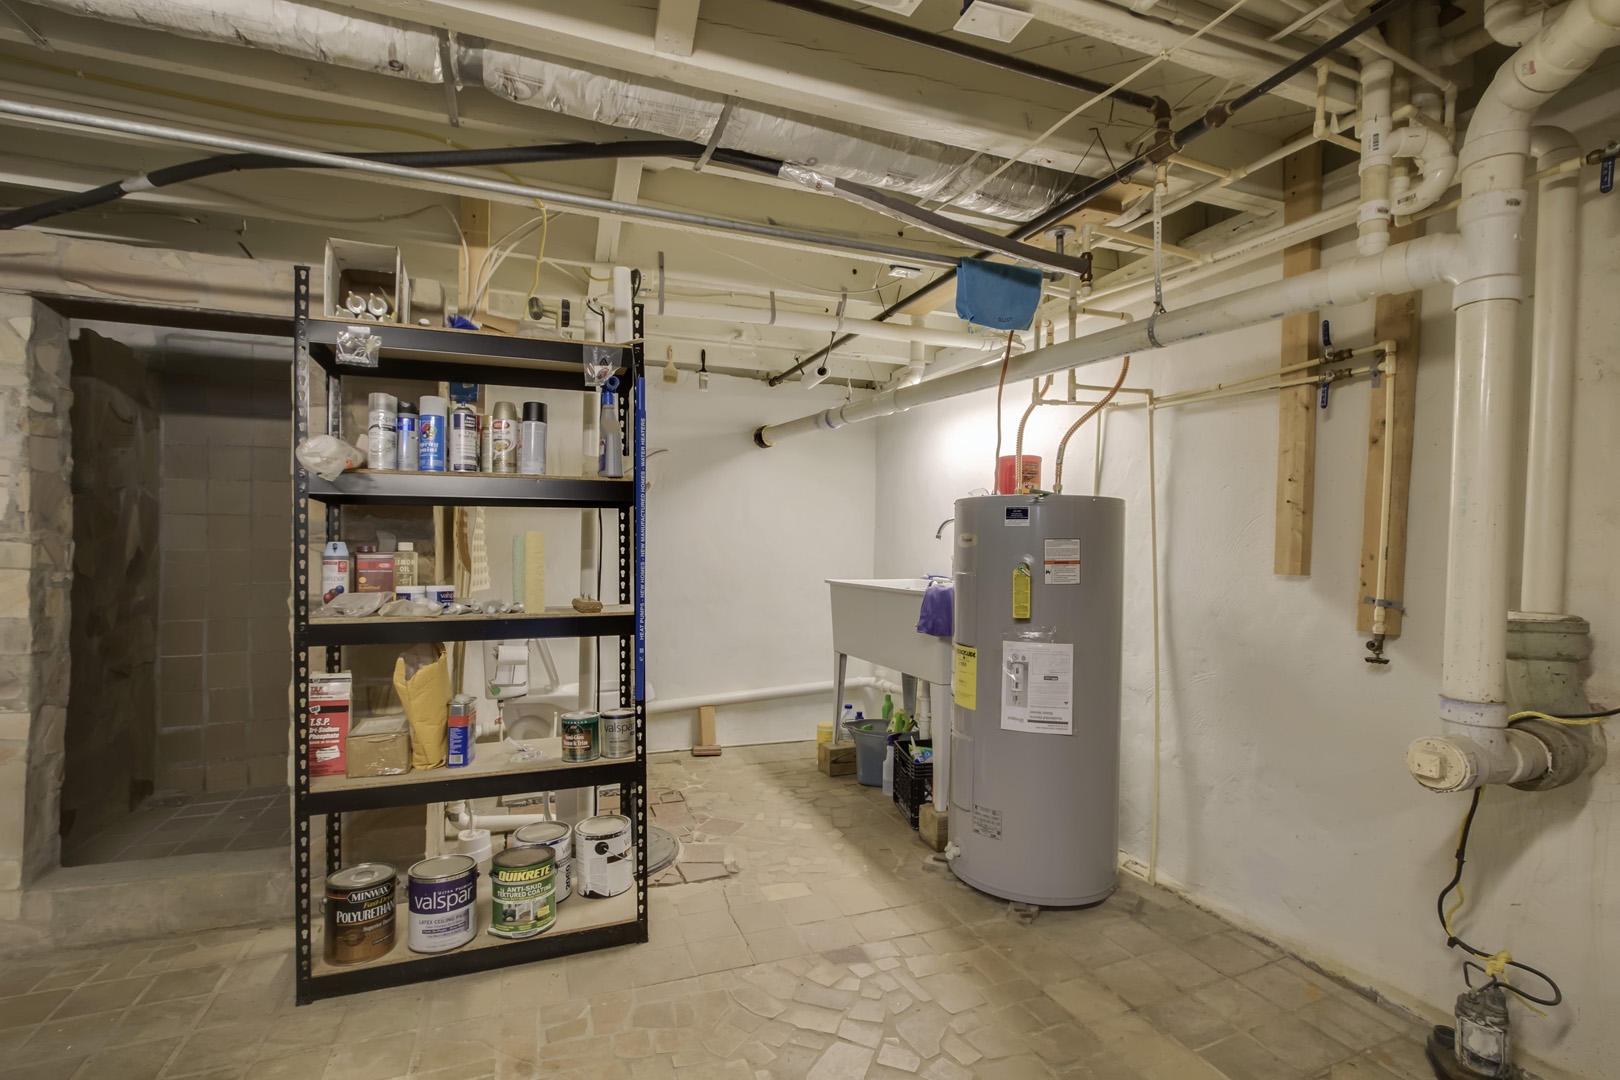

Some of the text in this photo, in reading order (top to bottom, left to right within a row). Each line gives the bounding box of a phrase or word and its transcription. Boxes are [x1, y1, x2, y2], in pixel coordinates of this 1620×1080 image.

[498, 864, 551, 882] QUIKRETE
[351, 886, 389, 902] MINWAX
[507, 882, 543, 894] ANTI-SKID
[414, 886, 473, 912] valspar
[336, 899, 395, 924] POLYURETHAN
